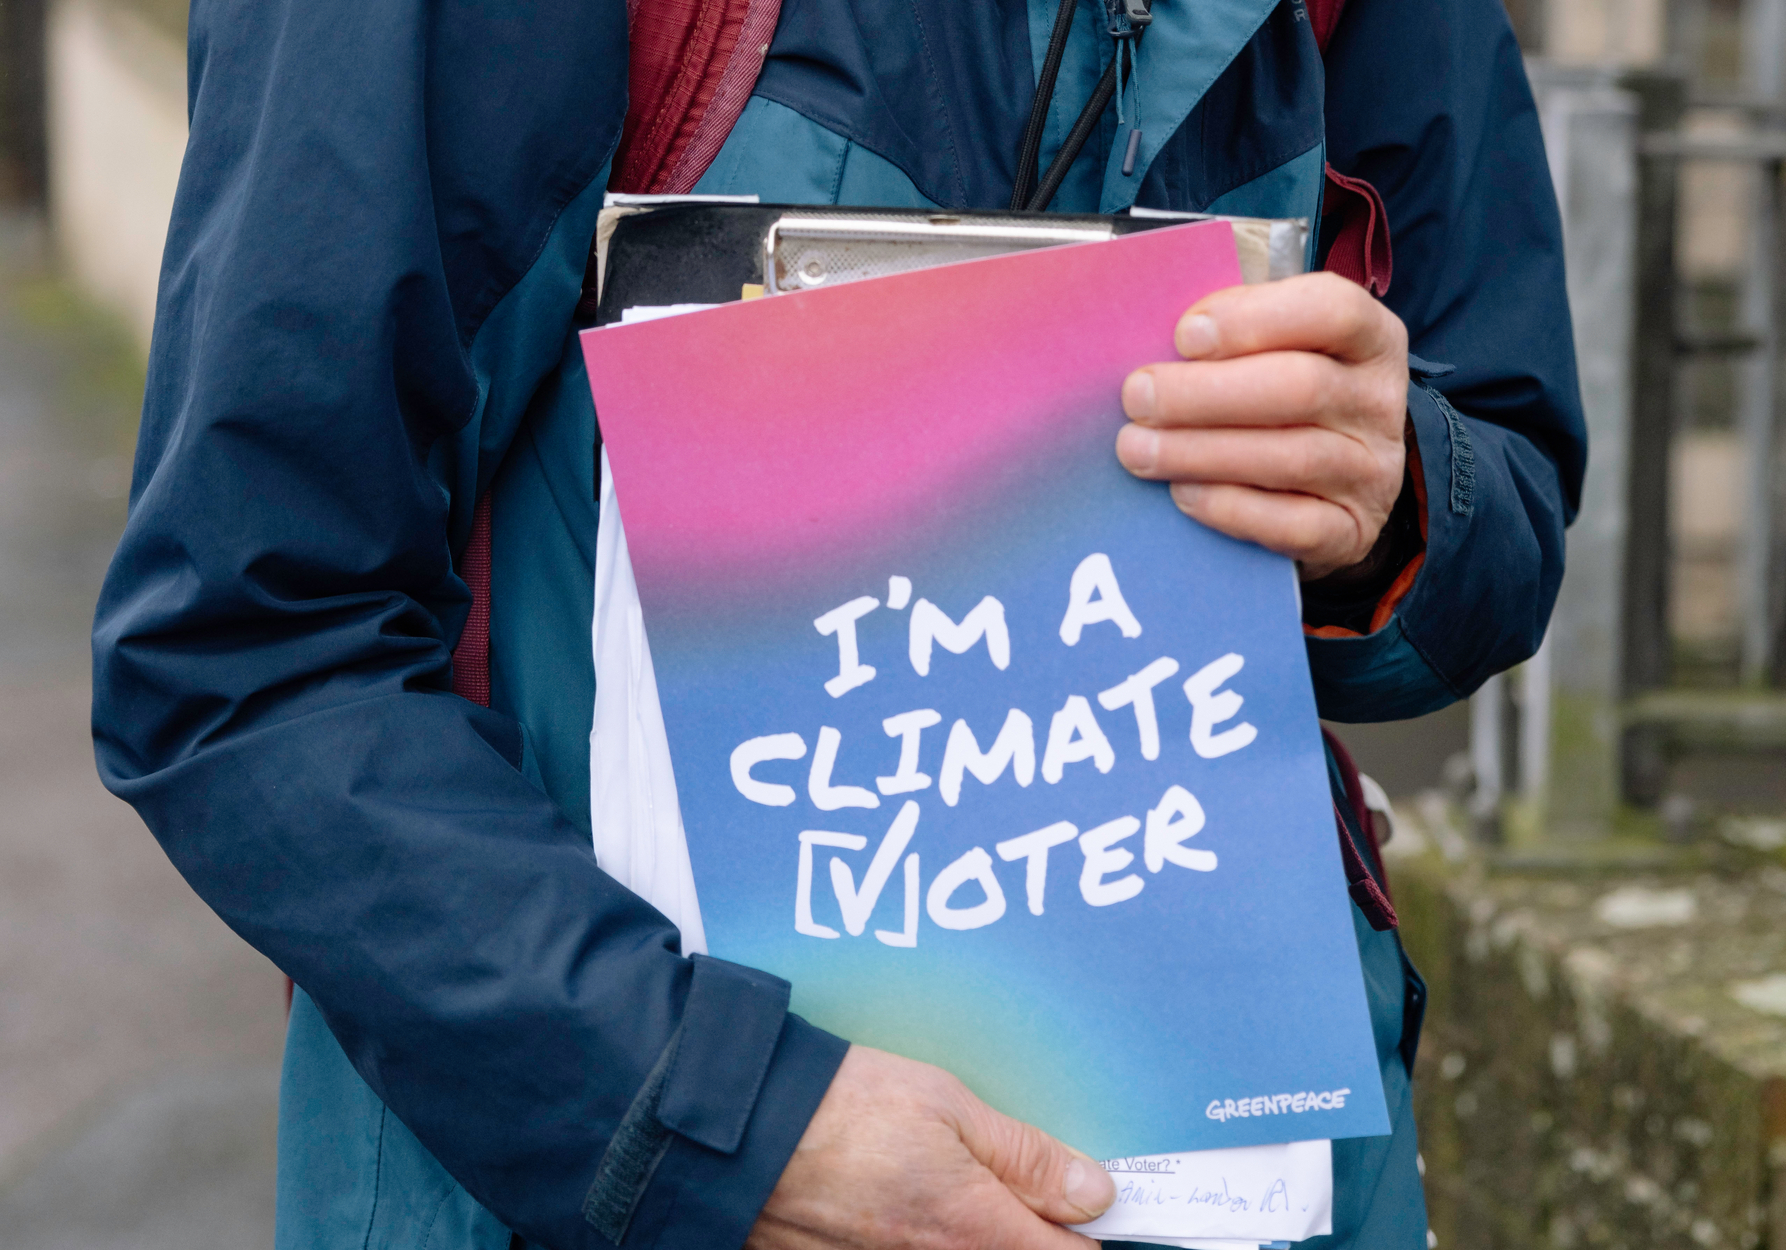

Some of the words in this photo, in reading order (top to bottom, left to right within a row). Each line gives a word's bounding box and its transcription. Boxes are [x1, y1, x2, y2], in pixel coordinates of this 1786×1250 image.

[813, 575, 1011, 698] I'M
[1059, 552, 1142, 647] A
[729, 652, 1258, 811] CLIMATE
[1205, 1087, 1351, 1123] GREENPEACE
[1098, 1158, 1121, 1171] ate
